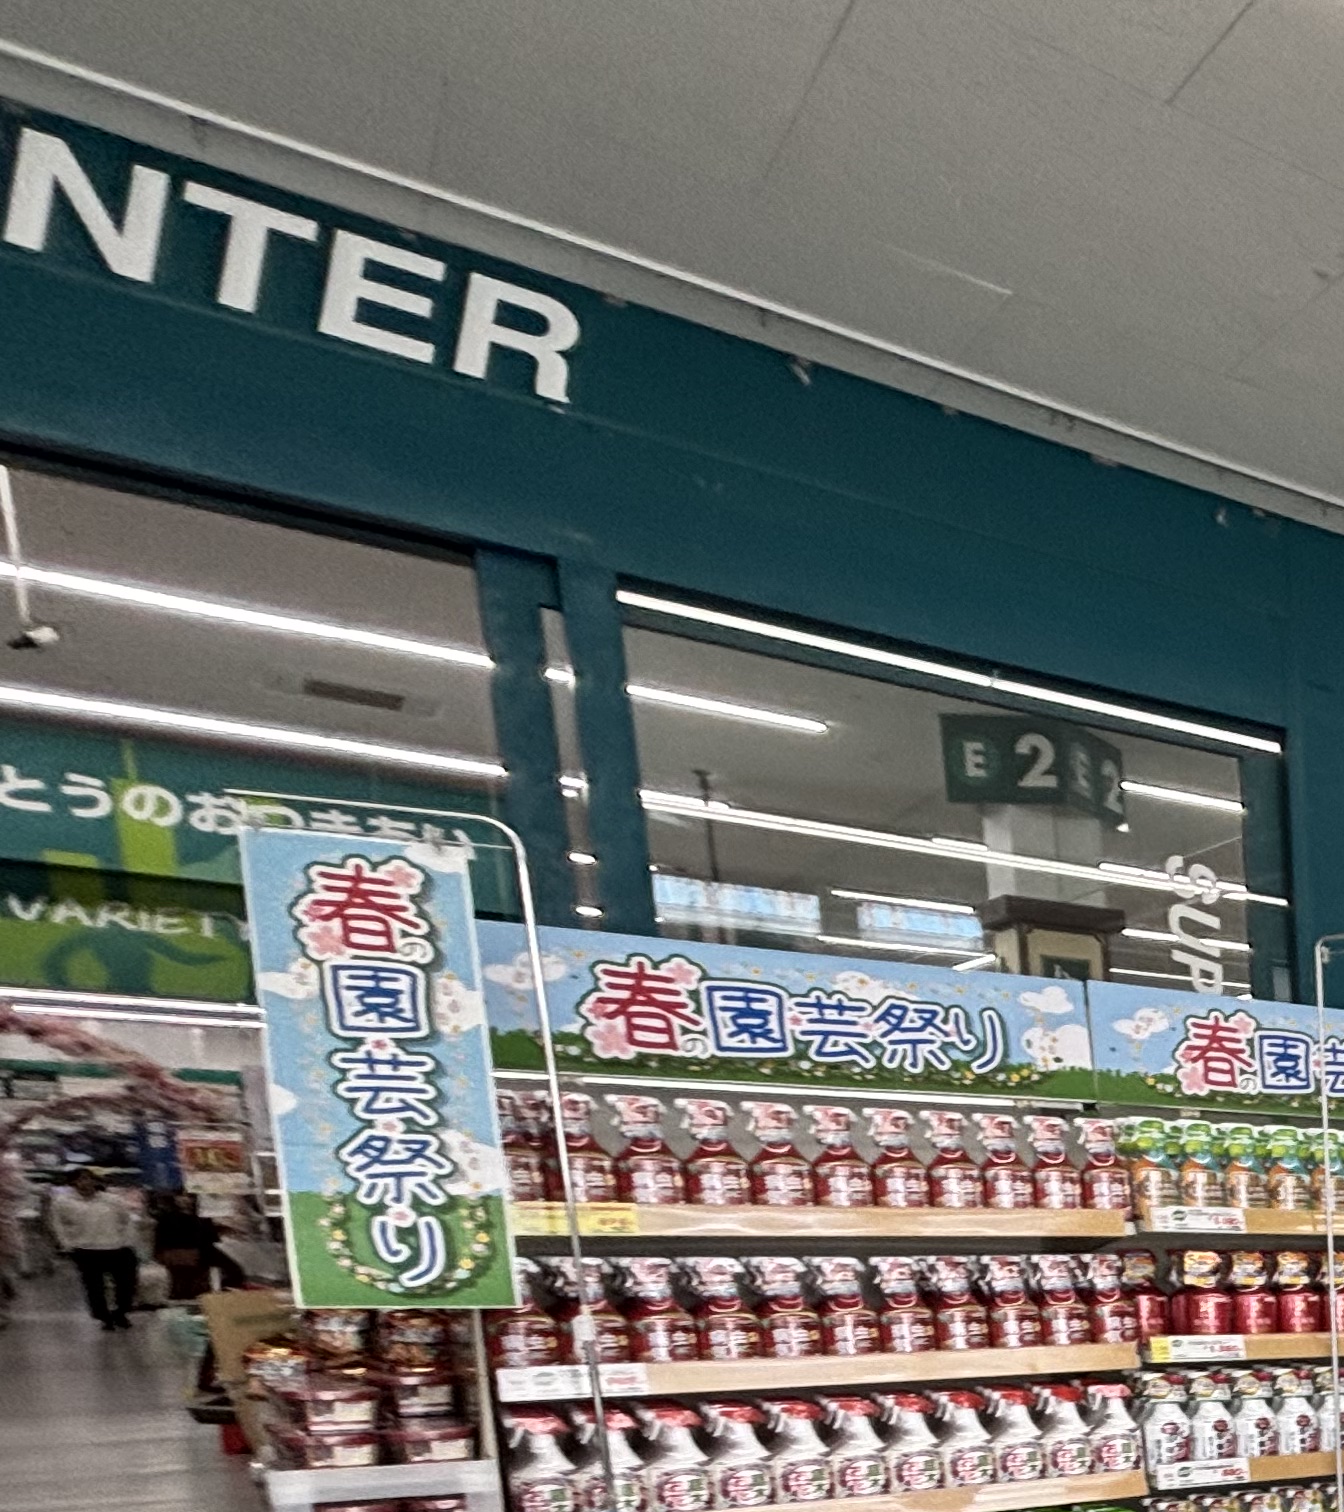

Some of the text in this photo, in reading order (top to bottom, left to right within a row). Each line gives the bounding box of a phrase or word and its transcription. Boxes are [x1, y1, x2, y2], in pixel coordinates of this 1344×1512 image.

[3, 127, 582, 404] NTER
[962, 732, 1058, 788] E 2
[8, 894, 252, 940] VARIET
[303, 857, 450, 1287] 春の園芸祭り
[592, 957, 1006, 1073] 春の園芸祭り
